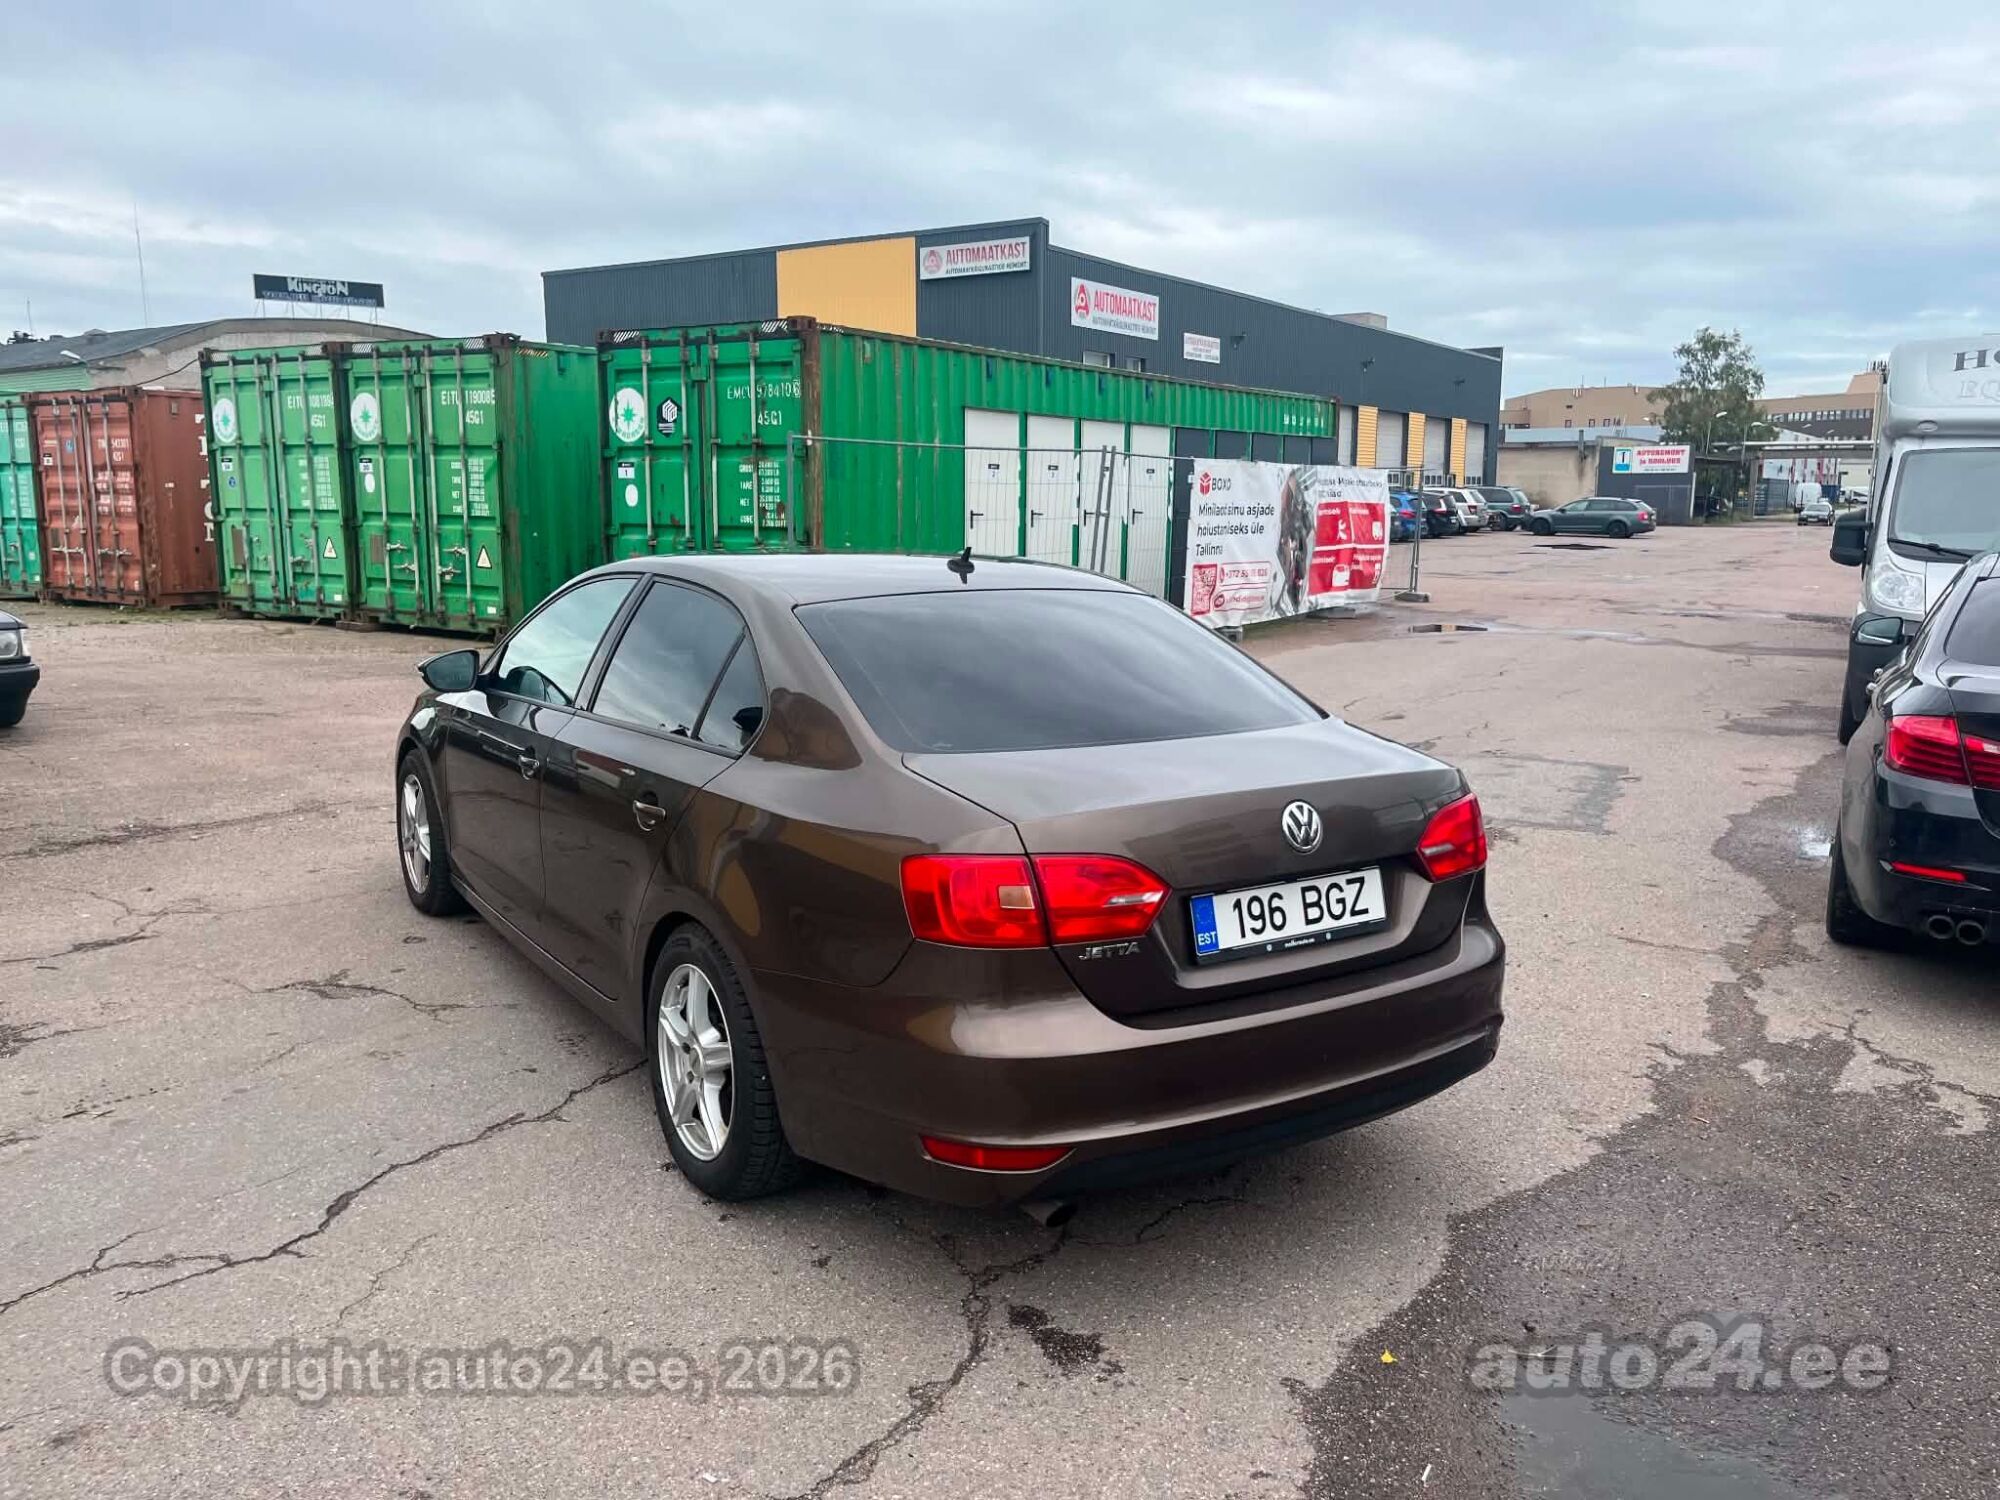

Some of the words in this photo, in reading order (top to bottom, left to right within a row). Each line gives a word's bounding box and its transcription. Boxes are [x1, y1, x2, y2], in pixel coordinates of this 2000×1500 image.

[945, 241, 1027, 266] AUTOMAATKAST
[1093, 290, 1157, 321] AUTOMAATKAST
[1212, 478, 1231, 491] BOXO
[1246, 503, 1275, 518] asjade
[1250, 522, 1264, 534] üle
[1232, 892, 1287, 939] 196
[1301, 876, 1369, 926] BGZ
[1198, 931, 1217, 946] EST
[1078, 941, 1140, 960] JETTA
